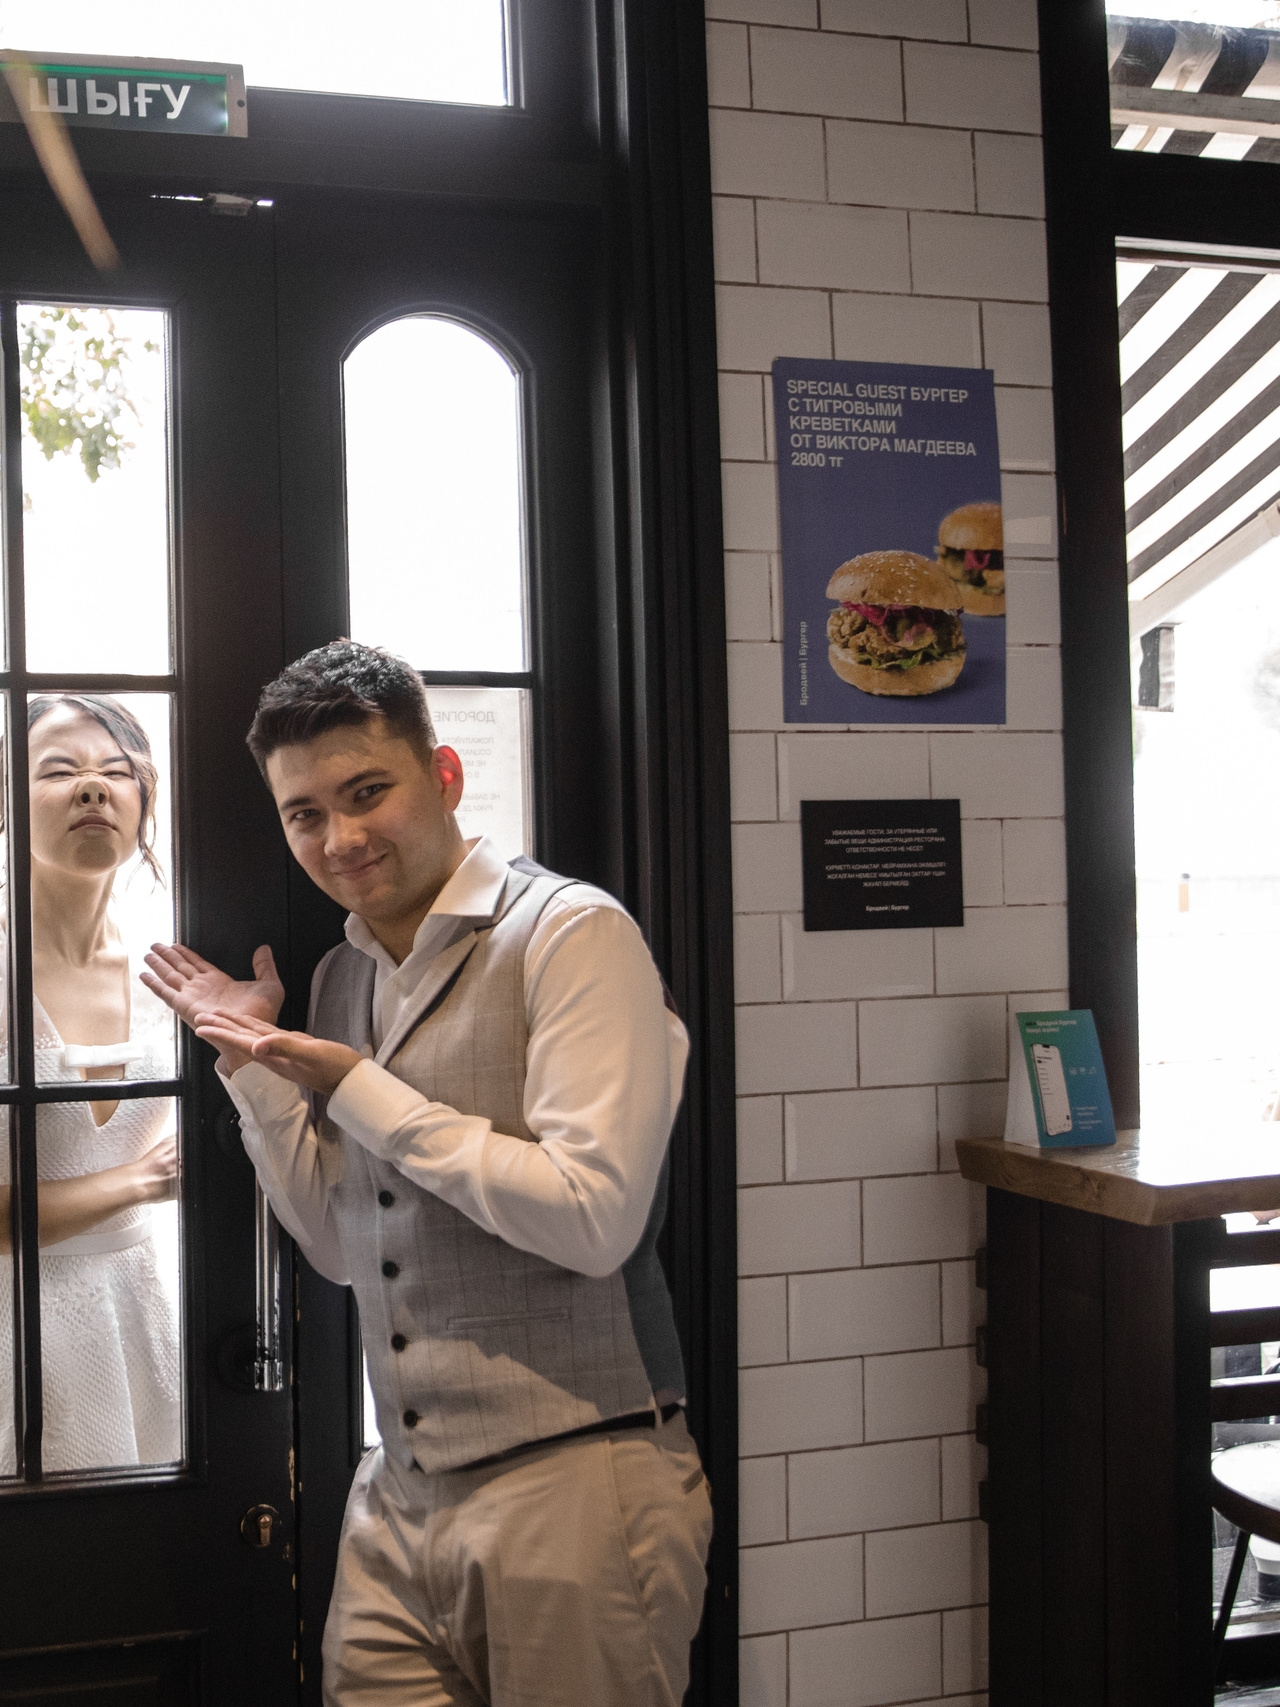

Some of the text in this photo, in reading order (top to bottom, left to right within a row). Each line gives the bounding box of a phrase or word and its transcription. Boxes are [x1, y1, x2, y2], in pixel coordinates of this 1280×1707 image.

[786, 379, 968, 403] SPECIAL GUEST БУРГЕР
[788, 397, 902, 417] С ТИГРОВЫМИ
[789, 415, 896, 434] КРЕВЕТКАМИ
[790, 433, 977, 457] ОТ ВИКТОРА МАГДЕЕВА
[791, 452, 844, 468] 2800 тг
[798, 621, 808, 656] Бургер
